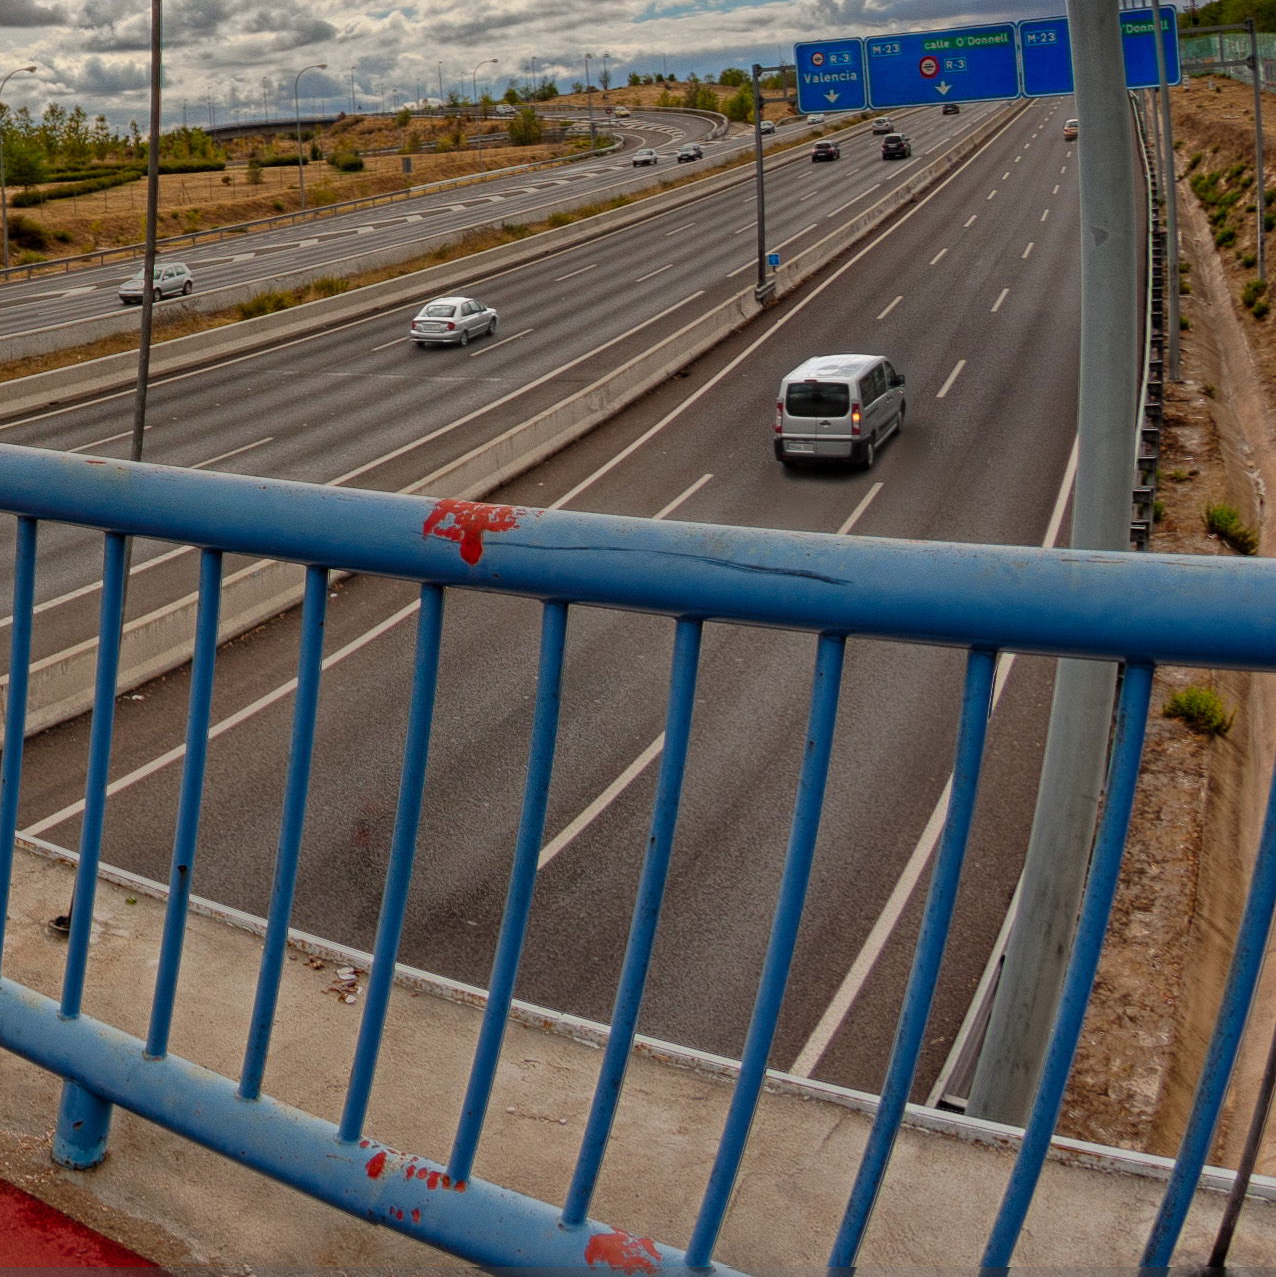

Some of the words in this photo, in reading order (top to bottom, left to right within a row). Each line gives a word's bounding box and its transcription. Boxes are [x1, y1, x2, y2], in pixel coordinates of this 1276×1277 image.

[924, 39, 950, 50] calle
[956, 33, 1008, 46] O'Donnell
[1027, 32, 1056, 43] M-23
[872, 44, 900, 55] M-23
[830, 53, 849, 64] R-3
[946, 59, 965, 69] R-3
[803, 71, 857, 84] Valencia
